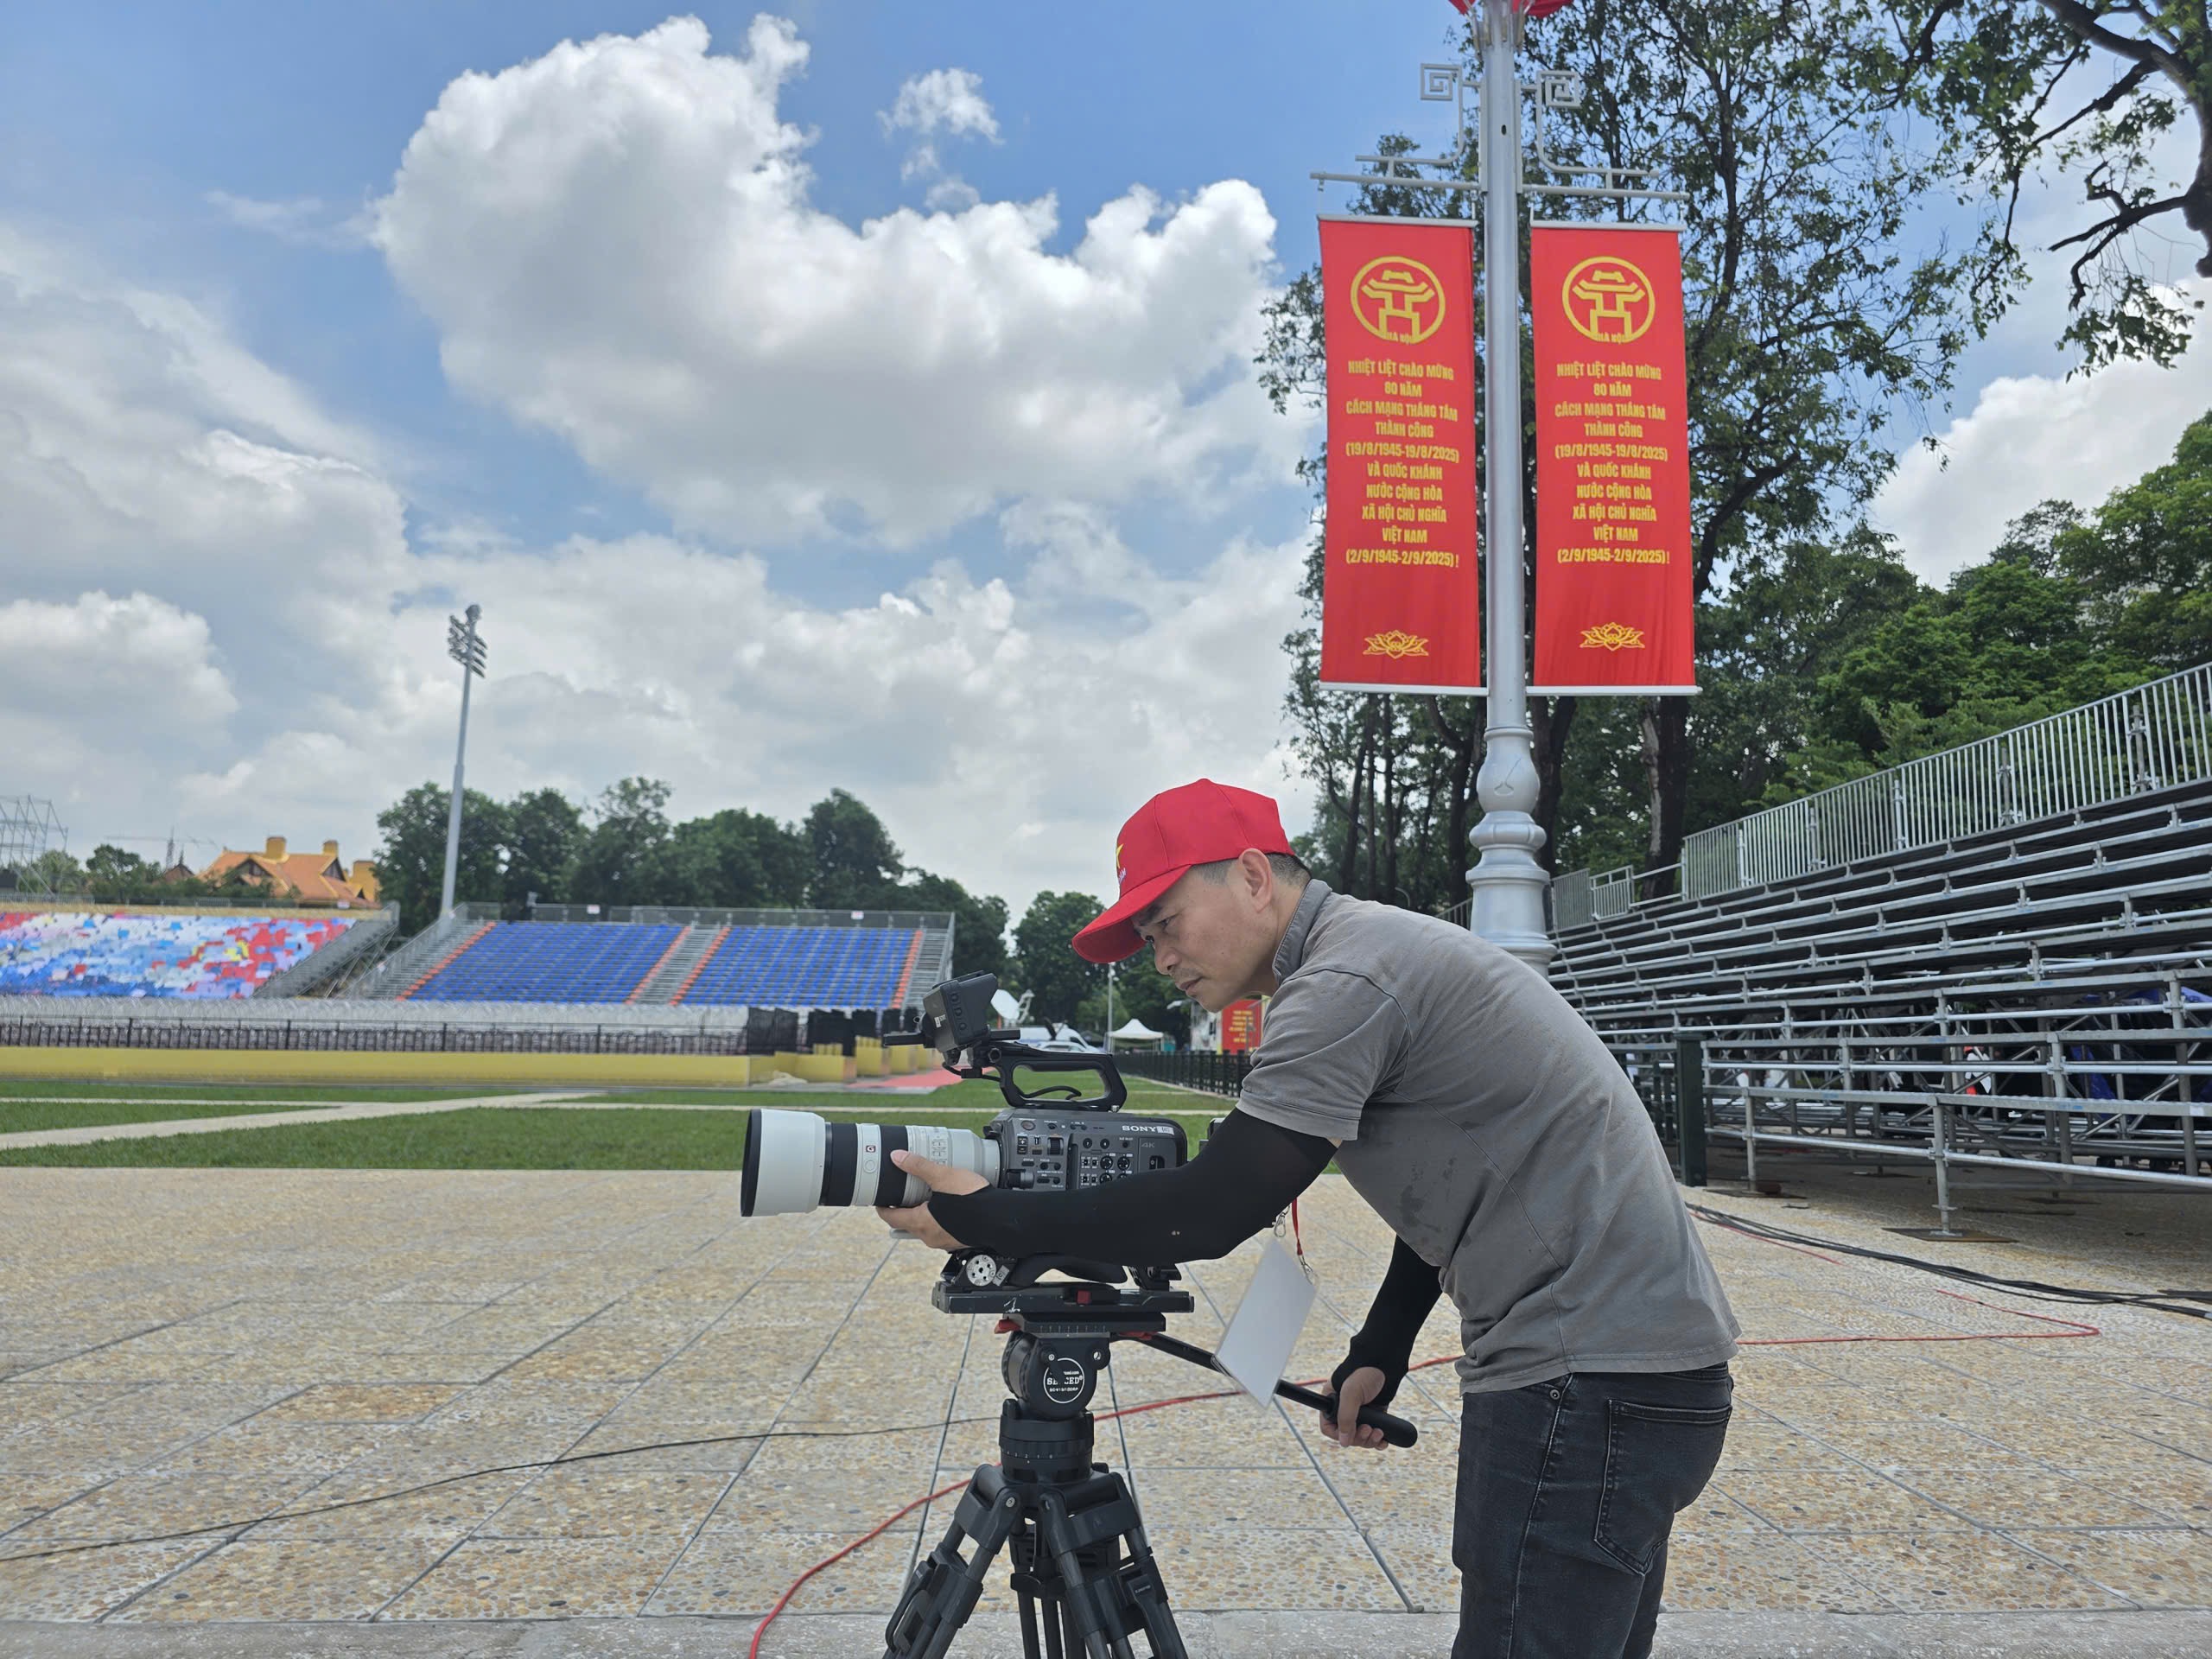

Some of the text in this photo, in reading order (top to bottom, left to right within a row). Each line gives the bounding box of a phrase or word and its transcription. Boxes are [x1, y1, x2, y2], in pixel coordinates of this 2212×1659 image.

[1349, 359, 1375, 375] NHIỆT
[1378, 359, 1396, 377] LIỆT
[1399, 363, 1423, 377] CHÀO
[1557, 361, 1584, 378] NHIỆT
[1587, 361, 1605, 378] LIỆT
[1608, 362, 1633, 377] CHÀO
[1385, 381, 1421, 397] 80 NĂM
[1594, 381, 1631, 397] 80 NĂM
[1346, 399, 1457, 421] CÁCH MẠNG THÁNG TÁM
[1555, 401, 1665, 420] CÁCH MẠNG THÁNG TÁM
[1376, 420, 1433, 437] THÀNH CÔNG
[1585, 421, 1643, 437] THÀNH CÔNG
[1346, 442, 1459, 463] (19/8/1945-19/8/2025)
[1555, 444, 1668, 461] (19/8/1945-19/8/2025)
[1368, 461, 1380, 476] VÀ
[1410, 464, 1442, 480] KHÁNH
[1577, 461, 1590, 477] VÀ
[1621, 463, 1650, 479] KHÁNH
[1395, 484, 1420, 501] CỘNG
[1606, 483, 1631, 500] CỘNG
[1363, 504, 1375, 519] XÃ
[1378, 504, 1394, 522] HỘI
[1418, 506, 1446, 522] NGHĨA
[1573, 504, 1586, 519] XÃ
[1589, 503, 1605, 521] HỘI
[1630, 505, 1656, 521] NGHĨA
[1382, 525, 1427, 543] VIỆT NAM
[1593, 524, 1637, 543] VIỆT NAM
[1046, 1376, 1080, 1385] SECED
